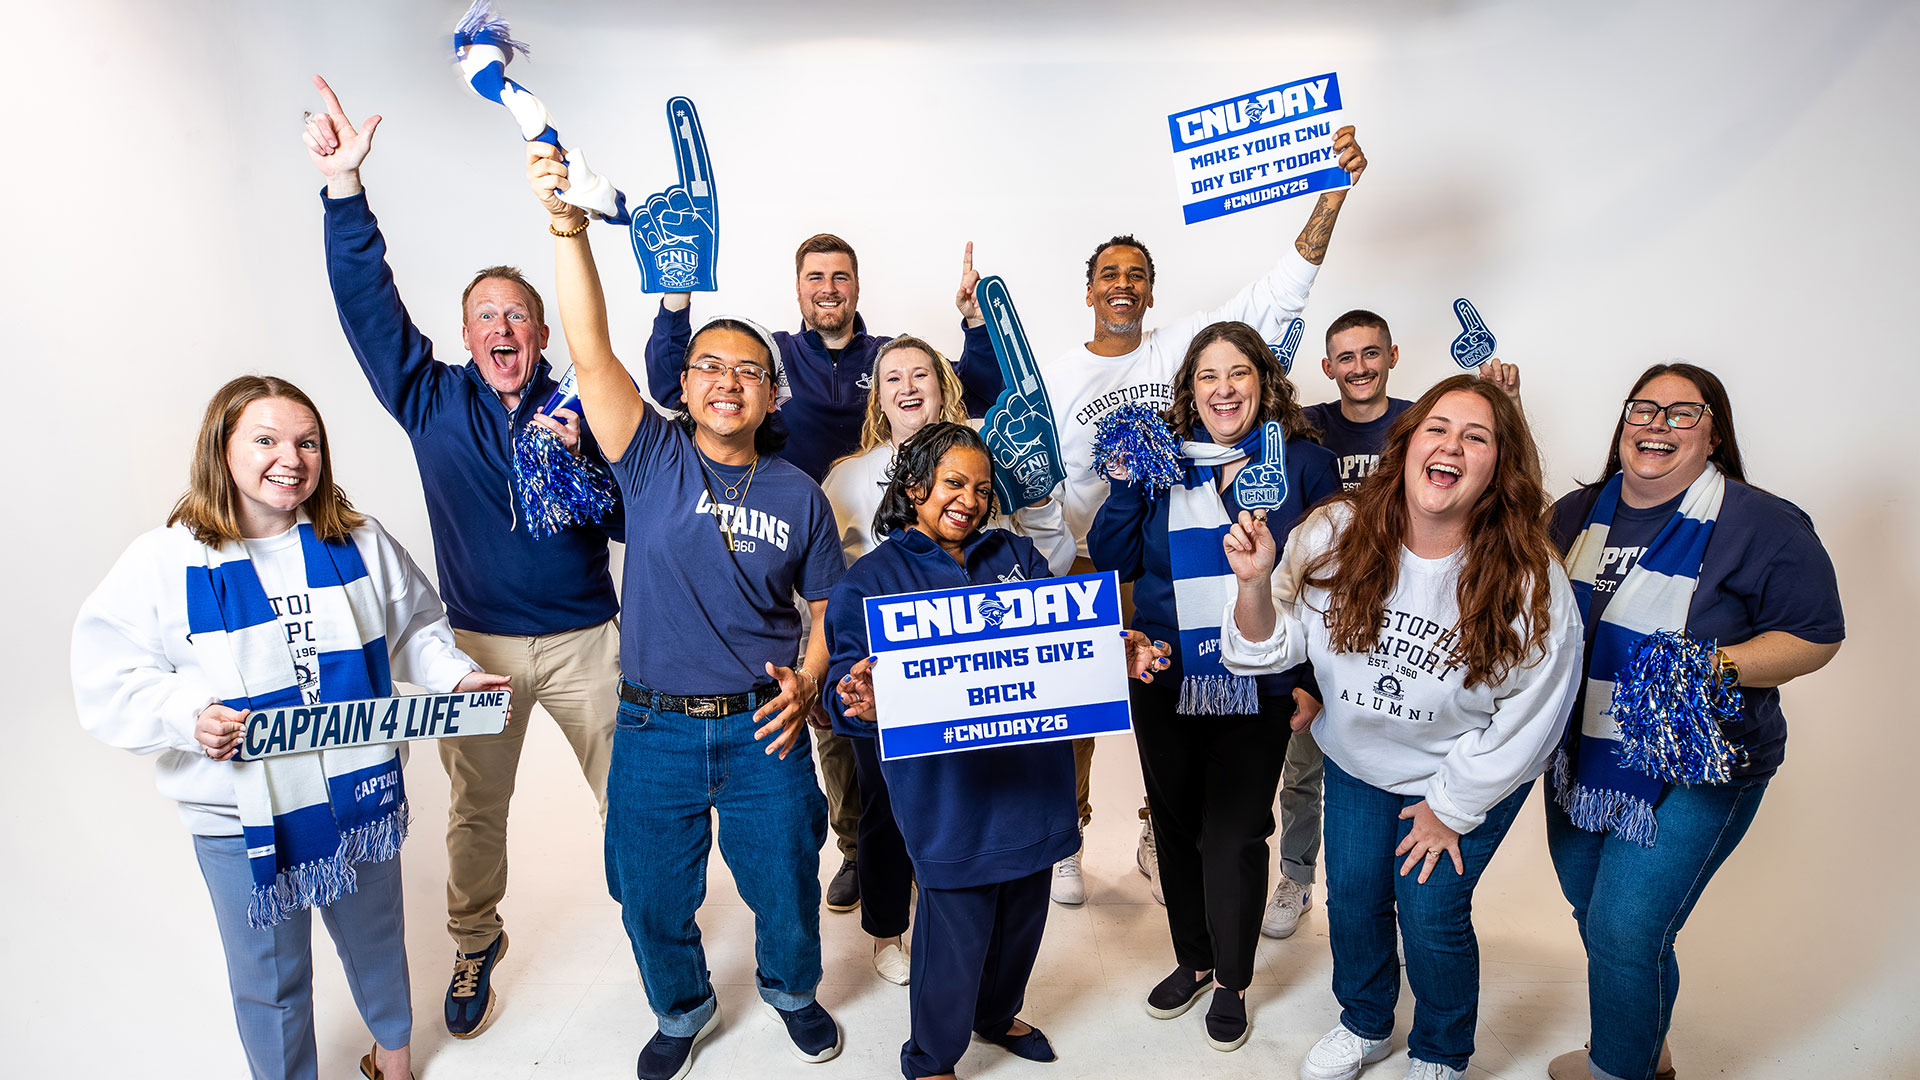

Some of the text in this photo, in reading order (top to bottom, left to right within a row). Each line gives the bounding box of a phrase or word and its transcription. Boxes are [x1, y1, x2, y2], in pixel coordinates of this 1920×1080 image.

[1176, 77, 1330, 144] CNU DAY
[1190, 121, 1331, 170] MAKE YOUR CNU
[1191, 174, 1224, 194] DAY
[1229, 163, 1270, 185] GIFT
[1224, 178, 1309, 210] #CNUDAY26
[657, 250, 696, 267] CNU
[1461, 341, 1492, 366] CNU
[1241, 487, 1280, 505] CNU
[733, 539, 756, 554] 960
[878, 579, 1104, 642] CNU DAY
[296, 646, 317, 659] 196
[902, 640, 1095, 680] CAPTAINS GIVE
[1367, 657, 1418, 680] EST. 1960
[966, 681, 1037, 707] BACK
[1340, 689, 1434, 721] ALUMNI
[245, 692, 505, 757] CAPTAIN 4 LIFE LANE
[943, 714, 1069, 744] #CNUDAY26
